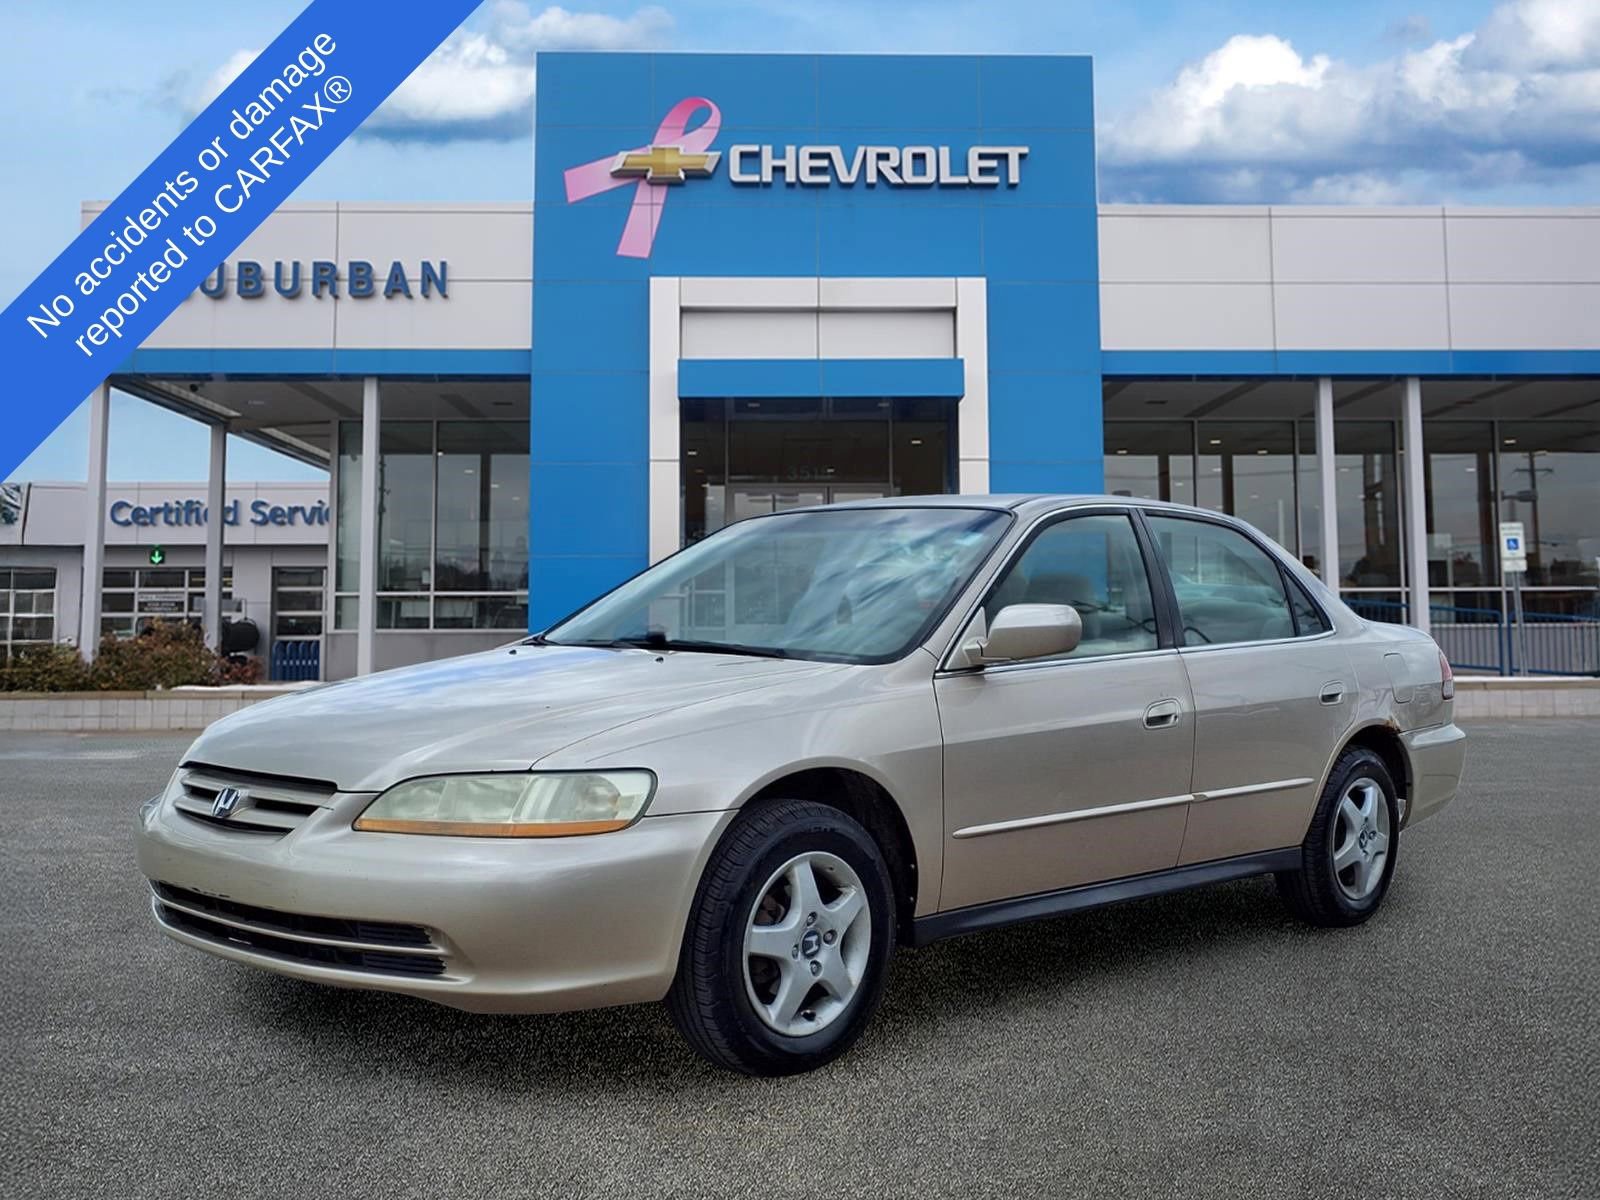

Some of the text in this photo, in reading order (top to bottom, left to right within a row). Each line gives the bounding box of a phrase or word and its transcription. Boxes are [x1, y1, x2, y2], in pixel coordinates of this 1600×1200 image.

[729, 144, 1029, 187] CHEVROLET
[199, 260, 449, 299] UBURBAN
[250, 500, 330, 527] Servi
